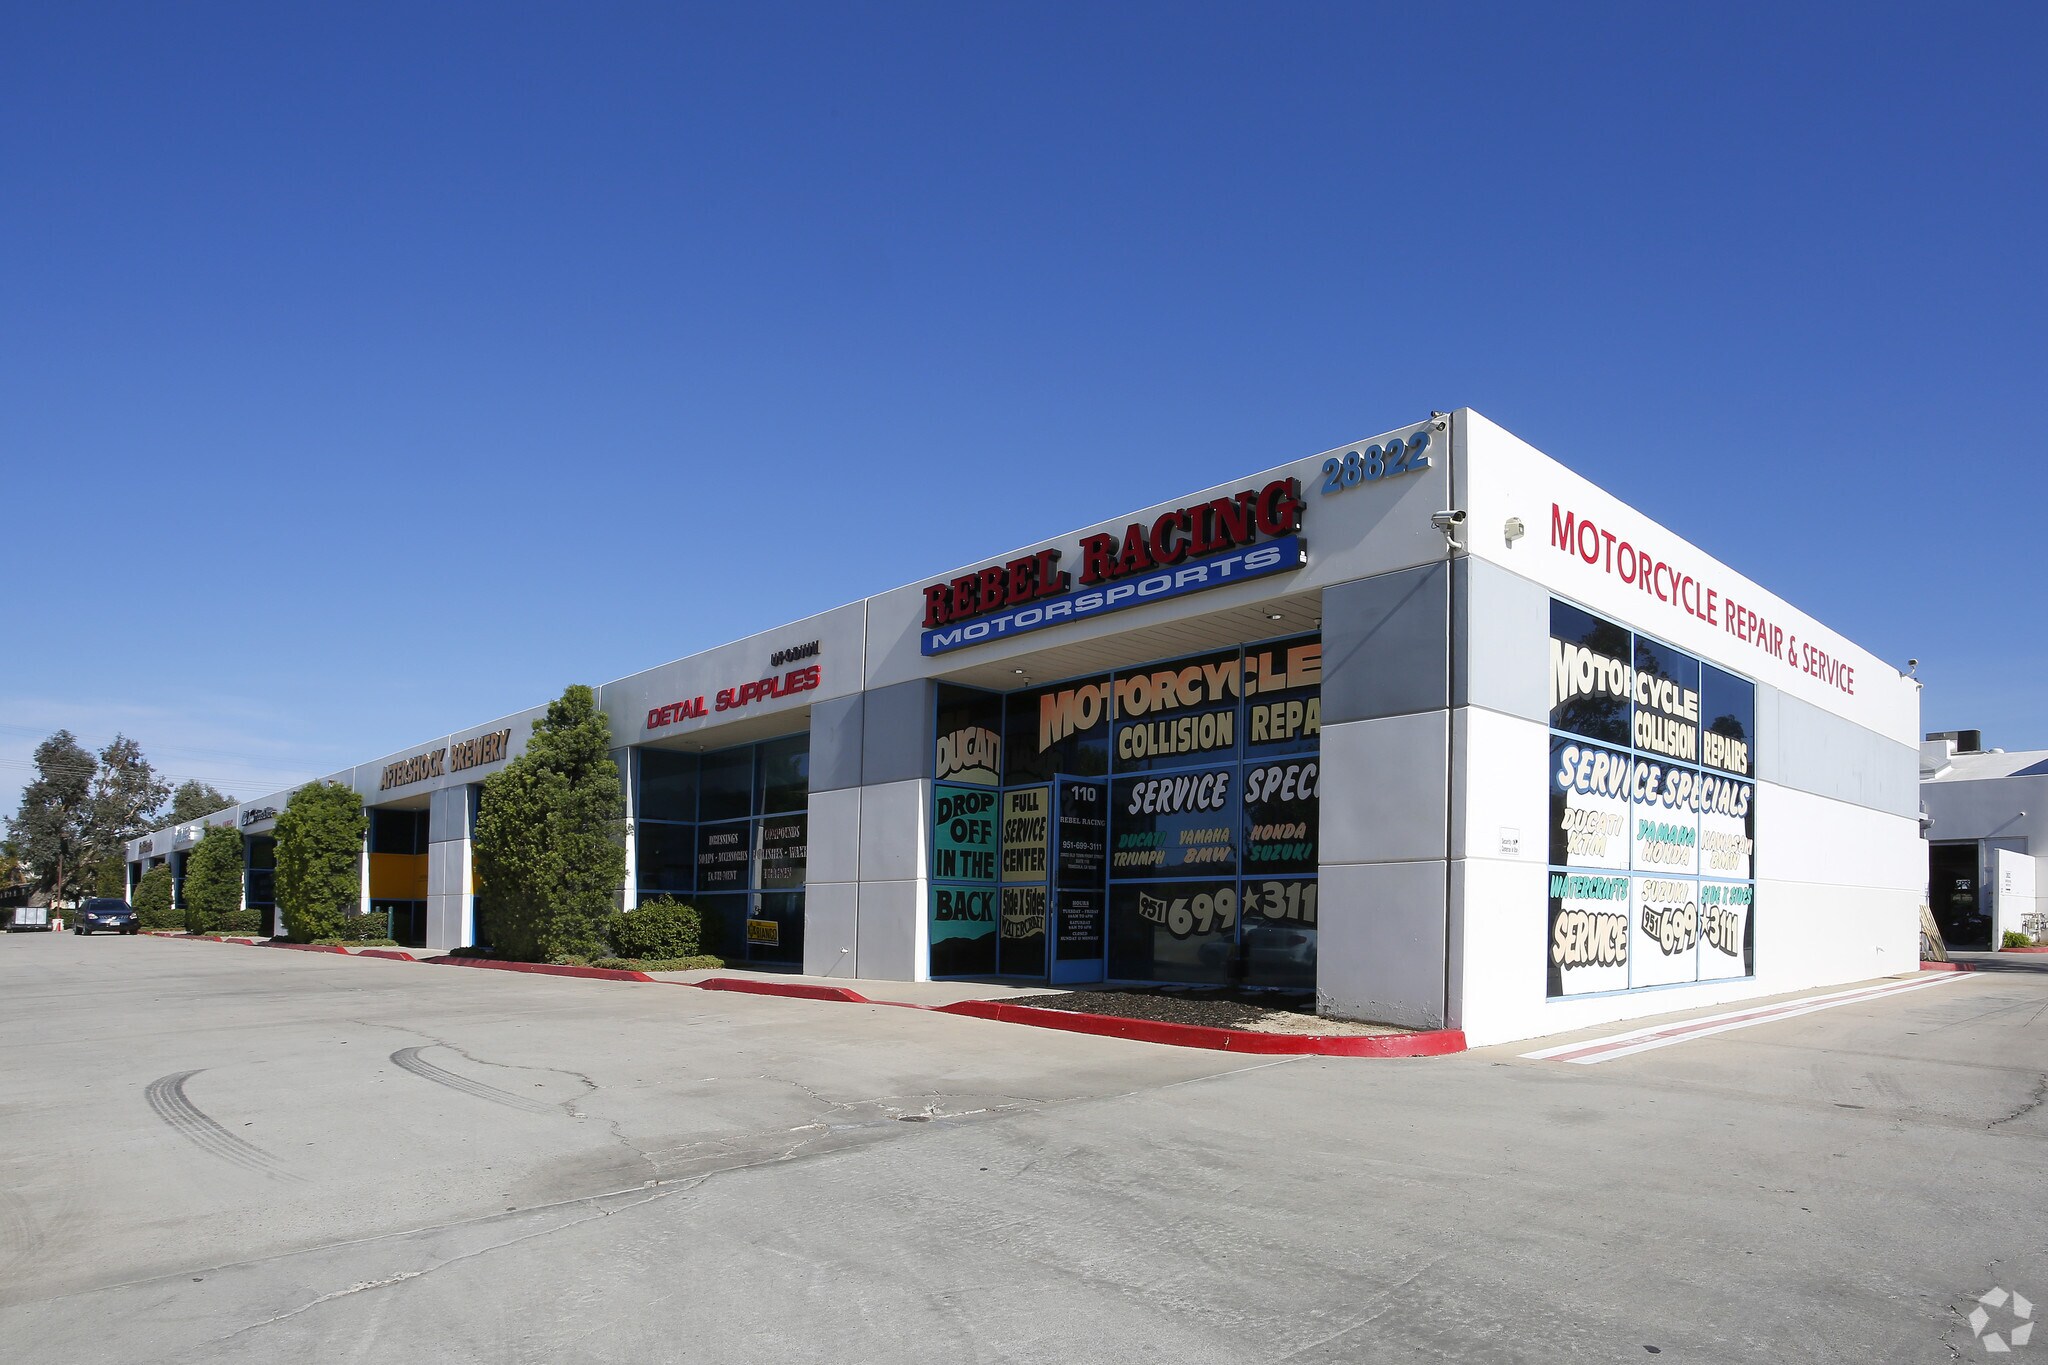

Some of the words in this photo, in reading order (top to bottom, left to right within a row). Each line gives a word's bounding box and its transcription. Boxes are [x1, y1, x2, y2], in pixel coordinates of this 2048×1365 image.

[1320, 431, 1433, 496] 28822
[922, 546, 1070, 629] REBEL
[1079, 476, 1307, 586] RACING
[930, 546, 1282, 650] MOTORSPORTS
[1551, 502, 1718, 626] MOTORCYCLE
[1725, 598, 1783, 661] REPAIR
[1788, 635, 1798, 669] &
[1802, 642, 1855, 696] SERVICE
[1549, 636, 1698, 722] MOTORCYCLE
[647, 696, 709, 729] DETAIL
[715, 664, 822, 712] SUPPLIES
[1039, 643, 1322, 754] MOTORCYCLE
[1119, 711, 1233, 760] COLLISION
[1634, 709, 1696, 761] COLLISION
[1703, 730, 1748, 775] REPAIRS
[380, 748, 446, 791] AFTERSHOCK
[450, 728, 511, 773] BREWERY
[1071, 786, 1096, 802] 110
[1128, 772, 1230, 815] SERVICE
[1558, 745, 1661, 803] SERVICE
[1663, 768, 1751, 817] SPECIALS
[936, 792, 995, 826] DROP
[1012, 792, 1039, 813] FULL
[951, 819, 992, 844] OFF
[1004, 816, 1046, 844] SERVICE
[1060, 816, 1081, 825] REBEL
[1082, 818, 1106, 827] RACING
[1250, 821, 1307, 841] HONDA
[1561, 807, 1624, 836] DUCATI
[1636, 819, 1696, 848] YAMAHA
[1119, 830, 1167, 849] DUCATI
[1179, 826, 1230, 846] YAMAHA
[1567, 829, 1607, 857] KTM
[937, 849, 956, 877] IN
[960, 851, 994, 878] THE
[1003, 847, 1046, 872] CENTER
[1113, 850, 1166, 867] TRIUMPH
[1183, 846, 1231, 864] BMW
[1249, 842, 1313, 861] SUZUKI
[1641, 840, 1690, 866] HONDA
[1709, 850, 1742, 870] BMW
[1550, 874, 1629, 900] WATERCRAFTS
[1641, 880, 1689, 904] SUZUKI
[1701, 886, 1721, 904] SIDE
[1730, 887, 1753, 905] SIDES
[935, 890, 995, 922] BACK
[1003, 888, 1018, 915] Side
[1018, 889, 1025, 915] X
[1026, 888, 1044, 916] Sides
[1140, 896, 1166, 922] 951
[1168, 887, 1237, 935] 699
[1002, 916, 1043, 938] WATERCRAFT
[1552, 909, 1629, 967] SERVICE
[1644, 911, 1660, 937] 951
[1660, 902, 1697, 955] 699
